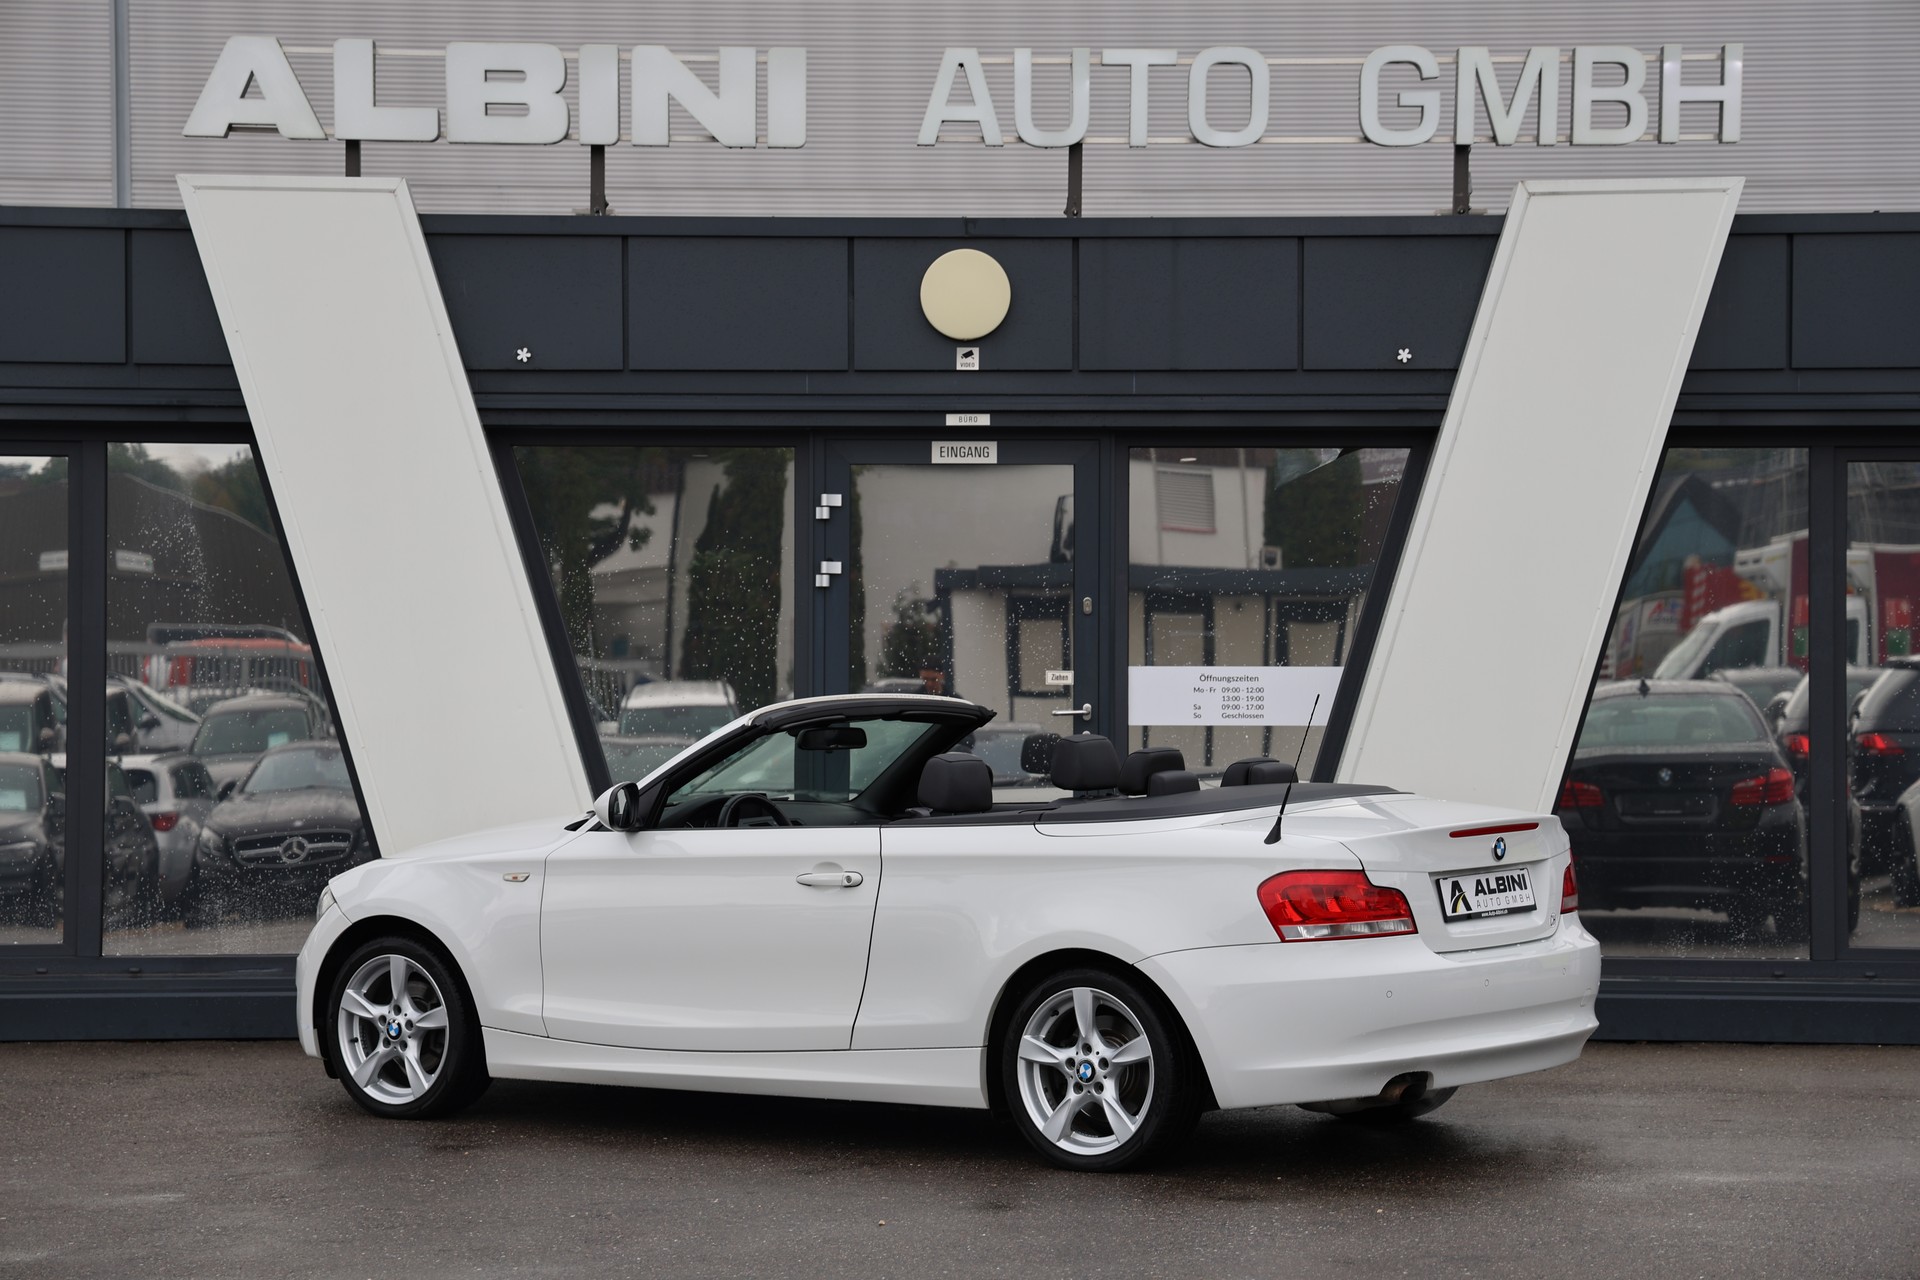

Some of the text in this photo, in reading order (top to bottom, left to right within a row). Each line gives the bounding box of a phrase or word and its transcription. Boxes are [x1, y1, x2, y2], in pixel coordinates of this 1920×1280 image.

[182, 35, 1744, 149] ALBINI AUTO GMBH
[958, 414, 978, 423] BÜRO
[939, 446, 990, 459] EINGANG
[1199, 674, 1259, 683] Öffnungszeiten
[1475, 873, 1527, 896] ALBINI
[1476, 893, 1531, 909] AUTO GMBH
